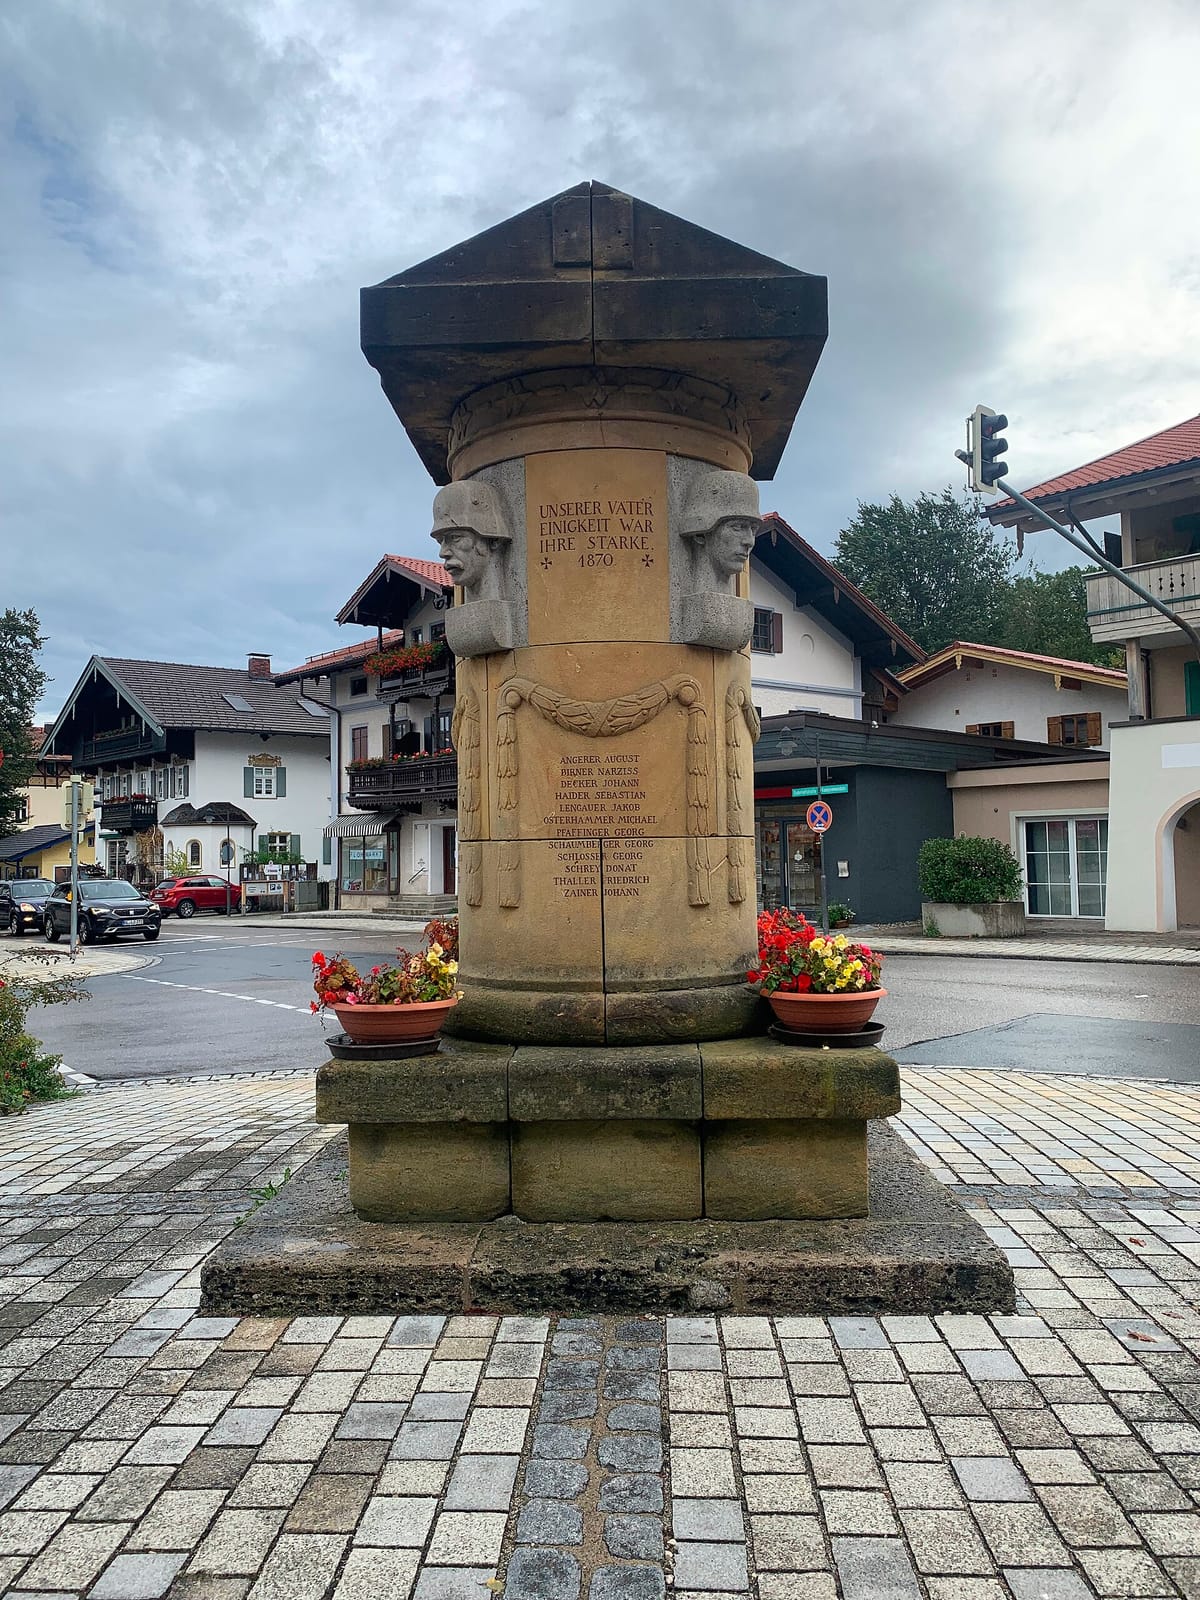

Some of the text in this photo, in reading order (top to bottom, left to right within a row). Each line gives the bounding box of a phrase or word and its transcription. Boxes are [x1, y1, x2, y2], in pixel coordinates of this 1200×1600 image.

[539, 501, 602, 518] UNSERER
[540, 519, 653, 536] EINIGKEIT WAR
[540, 537, 575, 553] IHRE
[560, 755, 640, 765] ANGERER AUGUST
[561, 767, 639, 777] BIRNER NARZISS
[561, 779, 639, 788] DECKER JOHANN
[555, 791, 646, 800] HAIDER SEBASTIAN
[560, 804, 640, 812] LENGAUER JAKOB
[544, 816, 657, 824] OSTERHAMMER MICHAEL
[557, 828, 645, 837] PFAFFINGER GEORG
[625, 840, 653, 848] GEORG
[613, 852, 643, 860] GEORG
[565, 864, 637, 873] SCHREY DONAT
[553, 876, 649, 885] THALLER RIEDRICH
[563, 888, 639, 897] ZAINER JOHANN
